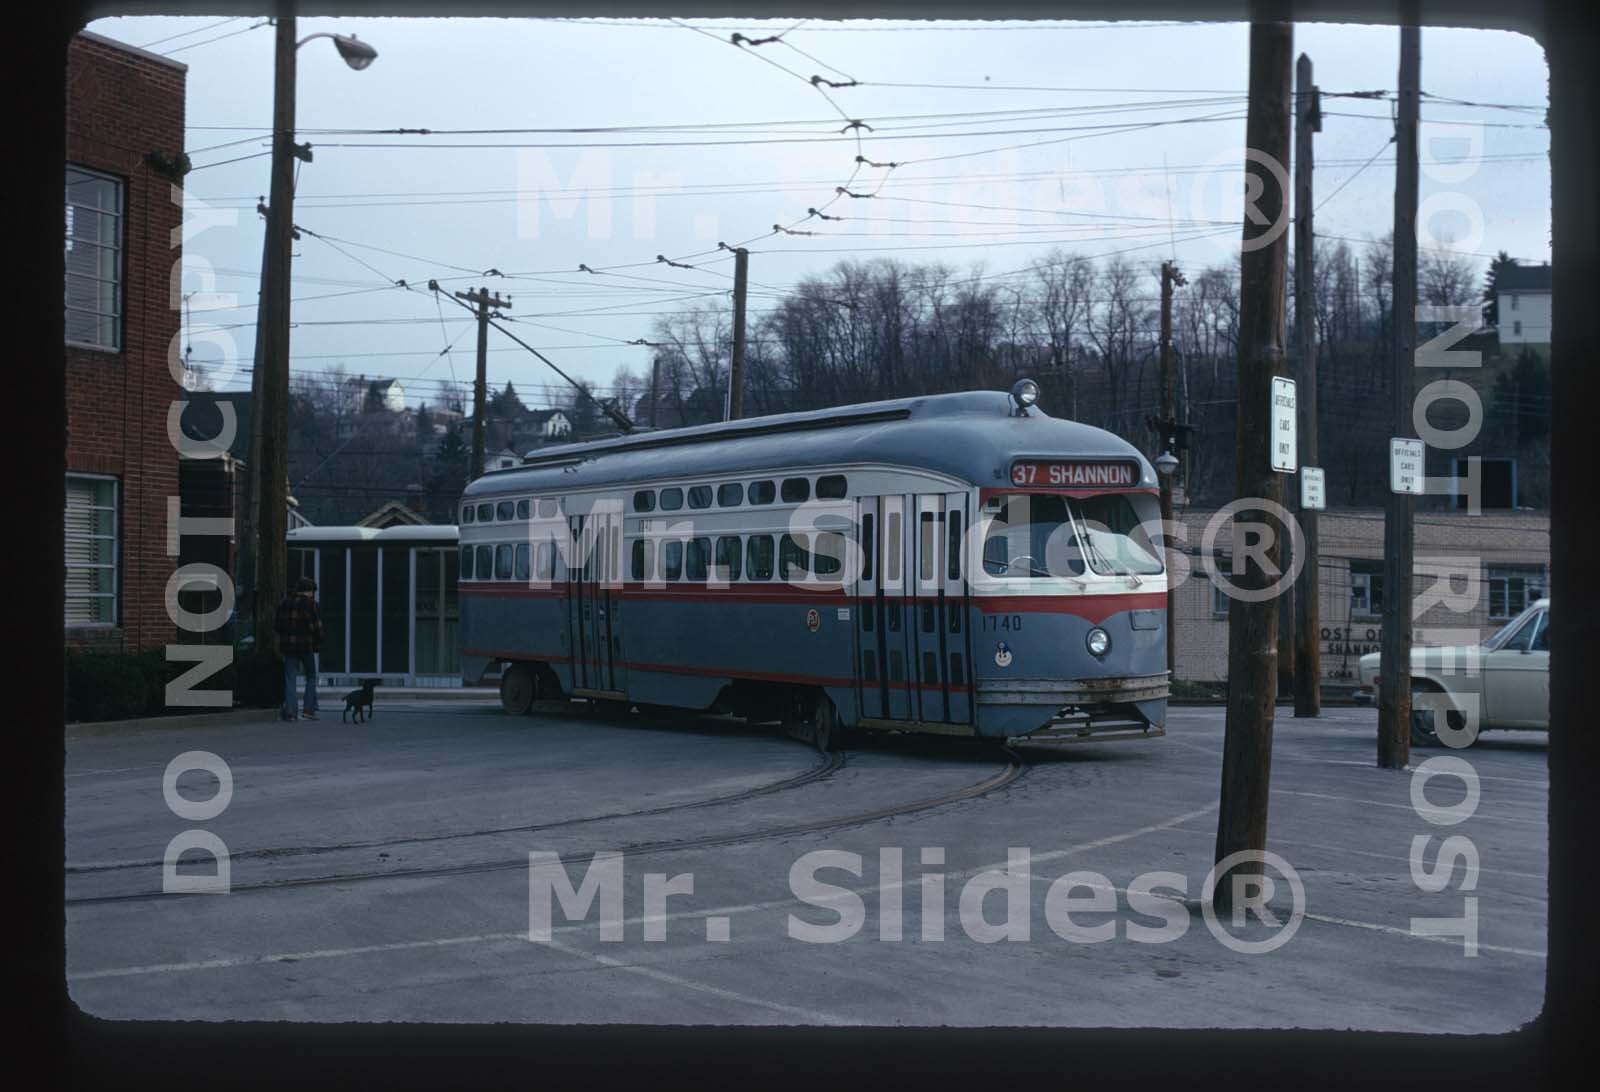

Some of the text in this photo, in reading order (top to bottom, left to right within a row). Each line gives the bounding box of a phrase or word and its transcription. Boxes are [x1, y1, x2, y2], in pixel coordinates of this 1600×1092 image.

[1012, 465, 1132, 484] 37 SHANNON
[982, 615, 1021, 632] 1740
[1320, 627, 1352, 641] OST
[1328, 642, 1380, 656] SHANNO
